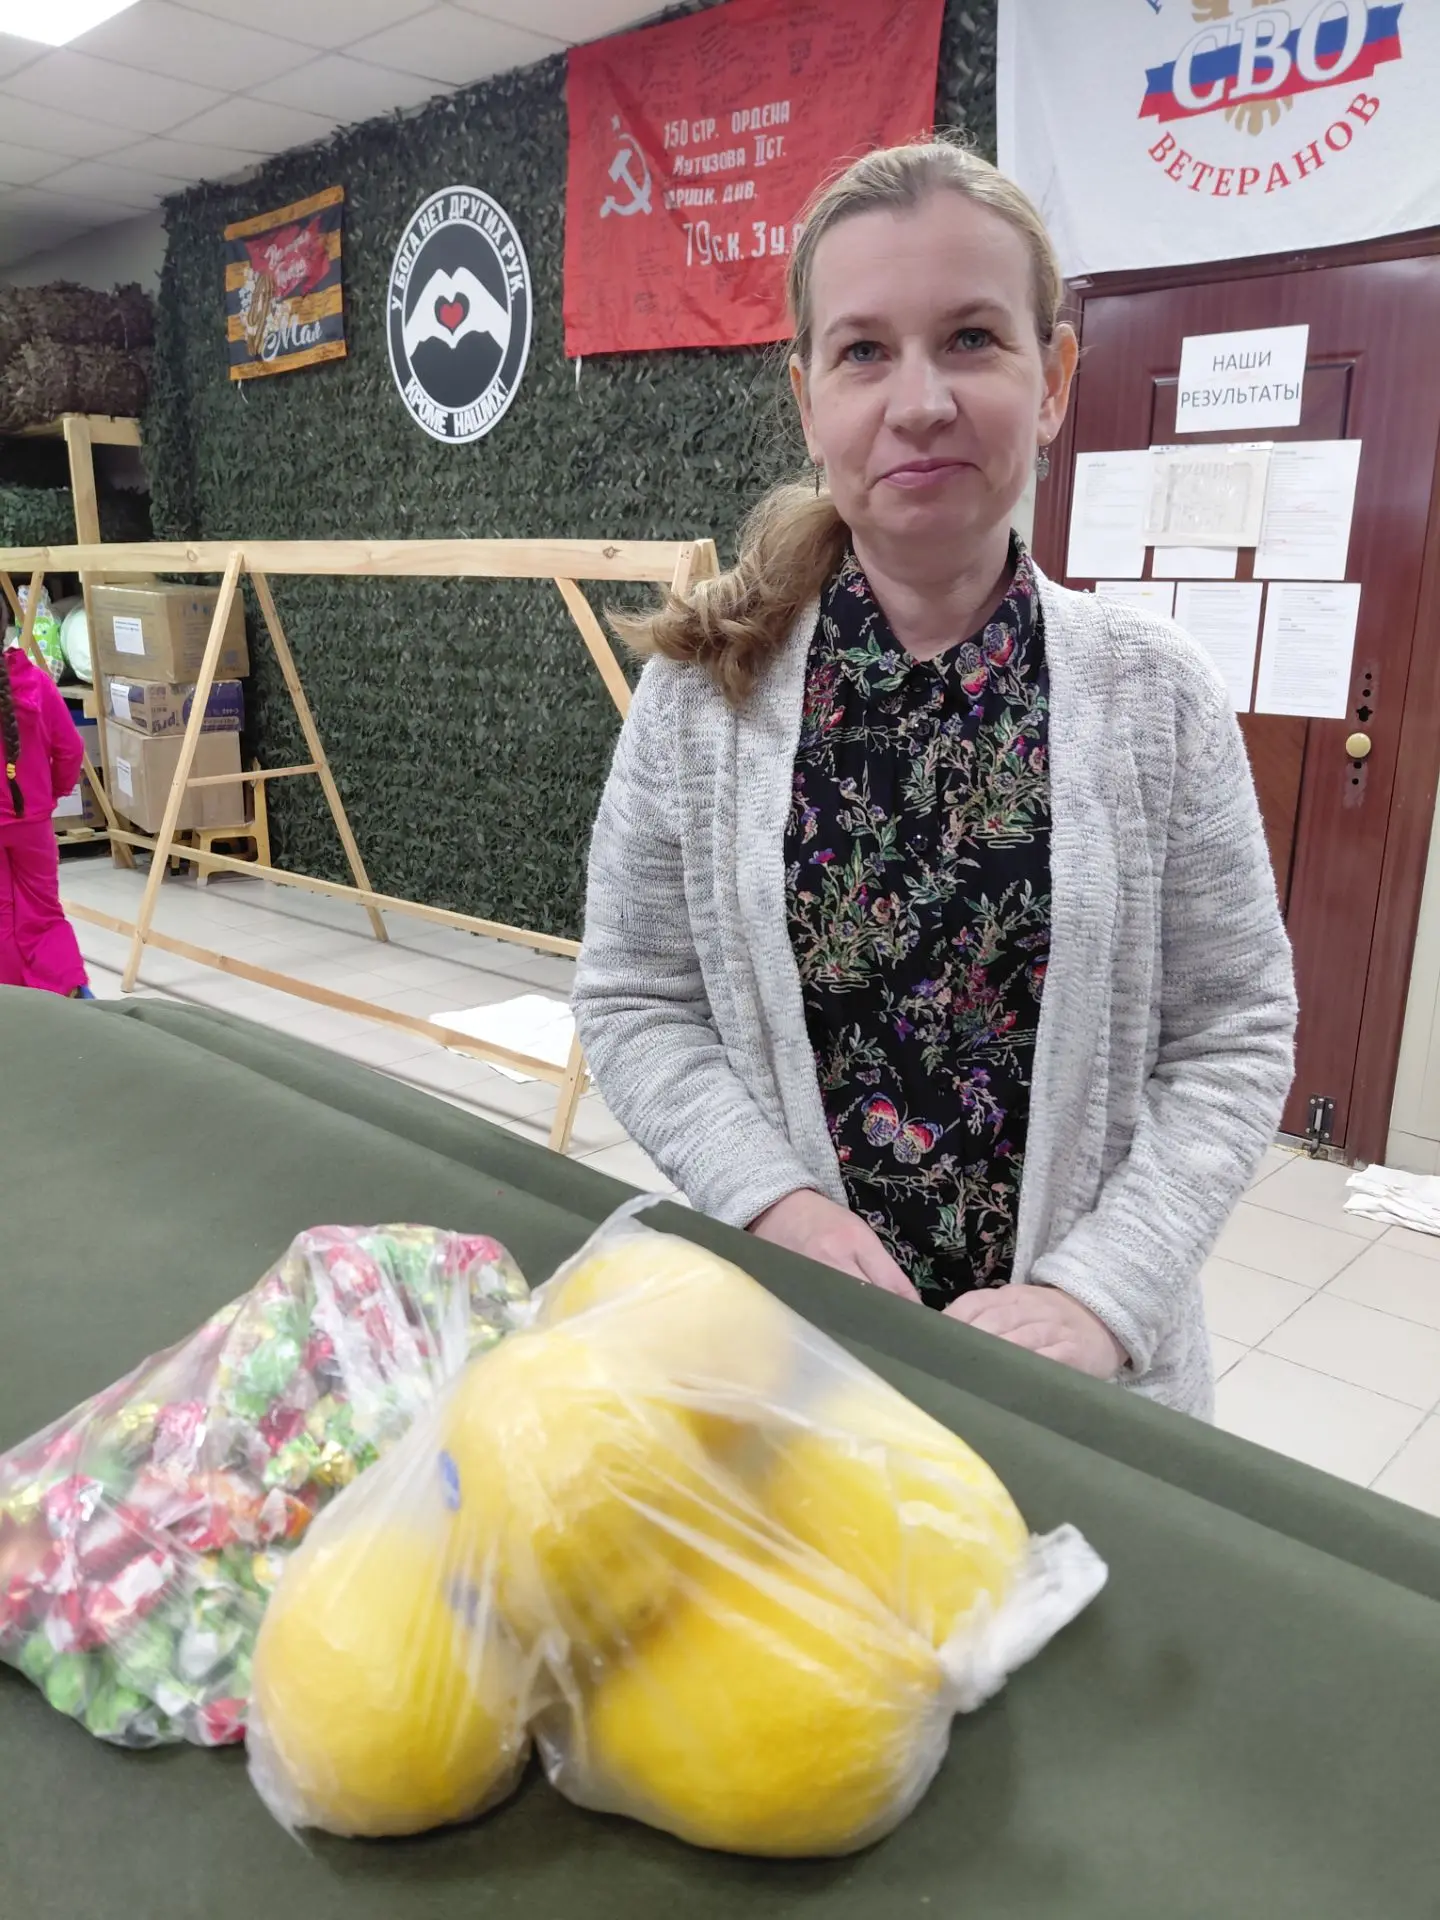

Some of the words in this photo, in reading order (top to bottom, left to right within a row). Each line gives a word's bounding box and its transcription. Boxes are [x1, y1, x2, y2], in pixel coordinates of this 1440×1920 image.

[1171, 0, 1368, 111] СВО
[663, 119, 688, 149] 150
[692, 118, 719, 144] СТР.
[731, 100, 790, 134] ОРДЕНА
[1148, 92, 1380, 197] ВЕТЕРАНОВ
[418, 199, 445, 237] НЕТ
[448, 194, 508, 246] ДРУГИХ
[394, 231, 421, 290] БОГА
[391, 295, 404, 310] У
[1212, 350, 1272, 373] НАШИ
[404, 375, 449, 436] КРОМЕ
[453, 376, 510, 437] НАШИХ!
[1181, 382, 1300, 409] РЕЗУЛЬТАТЫ
